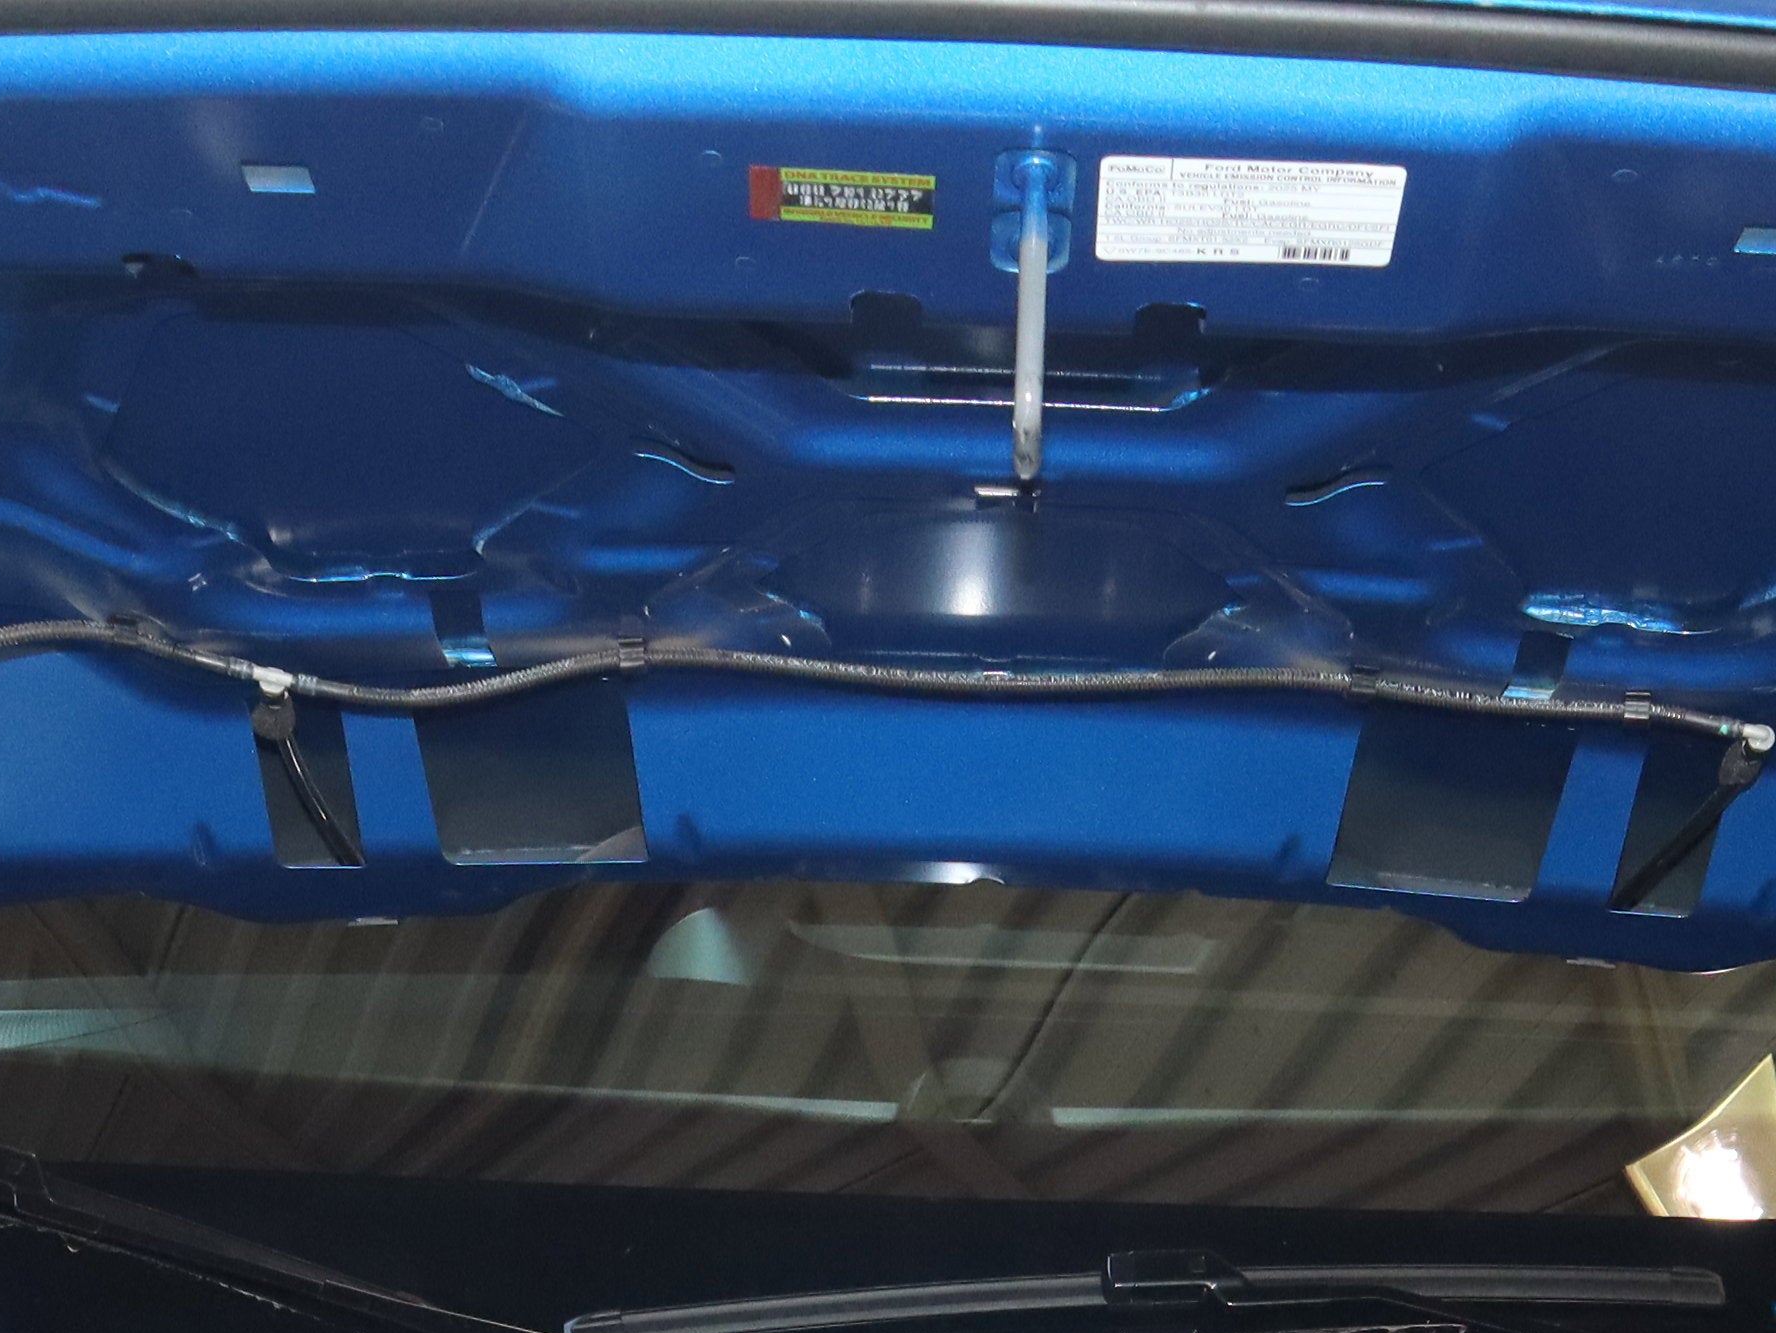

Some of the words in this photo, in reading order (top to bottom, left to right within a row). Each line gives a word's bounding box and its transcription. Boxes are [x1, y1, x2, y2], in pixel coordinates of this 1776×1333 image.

[784, 170, 817, 180] DNA
[823, 172, 870, 183] TRACE
[873, 175, 931, 186] SYSTEM
[1205, 164, 1241, 172] Ford
[1247, 166, 1292, 174] Motor
[1299, 166, 1374, 178] Company
[1180, 172, 1223, 180] VEHICLE
[1225, 173, 1274, 182] EMISSION
[1277, 175, 1322, 183] CONTROL
[1326, 176, 1396, 186] INFORMATION
[1196, 247, 1206, 255] K
